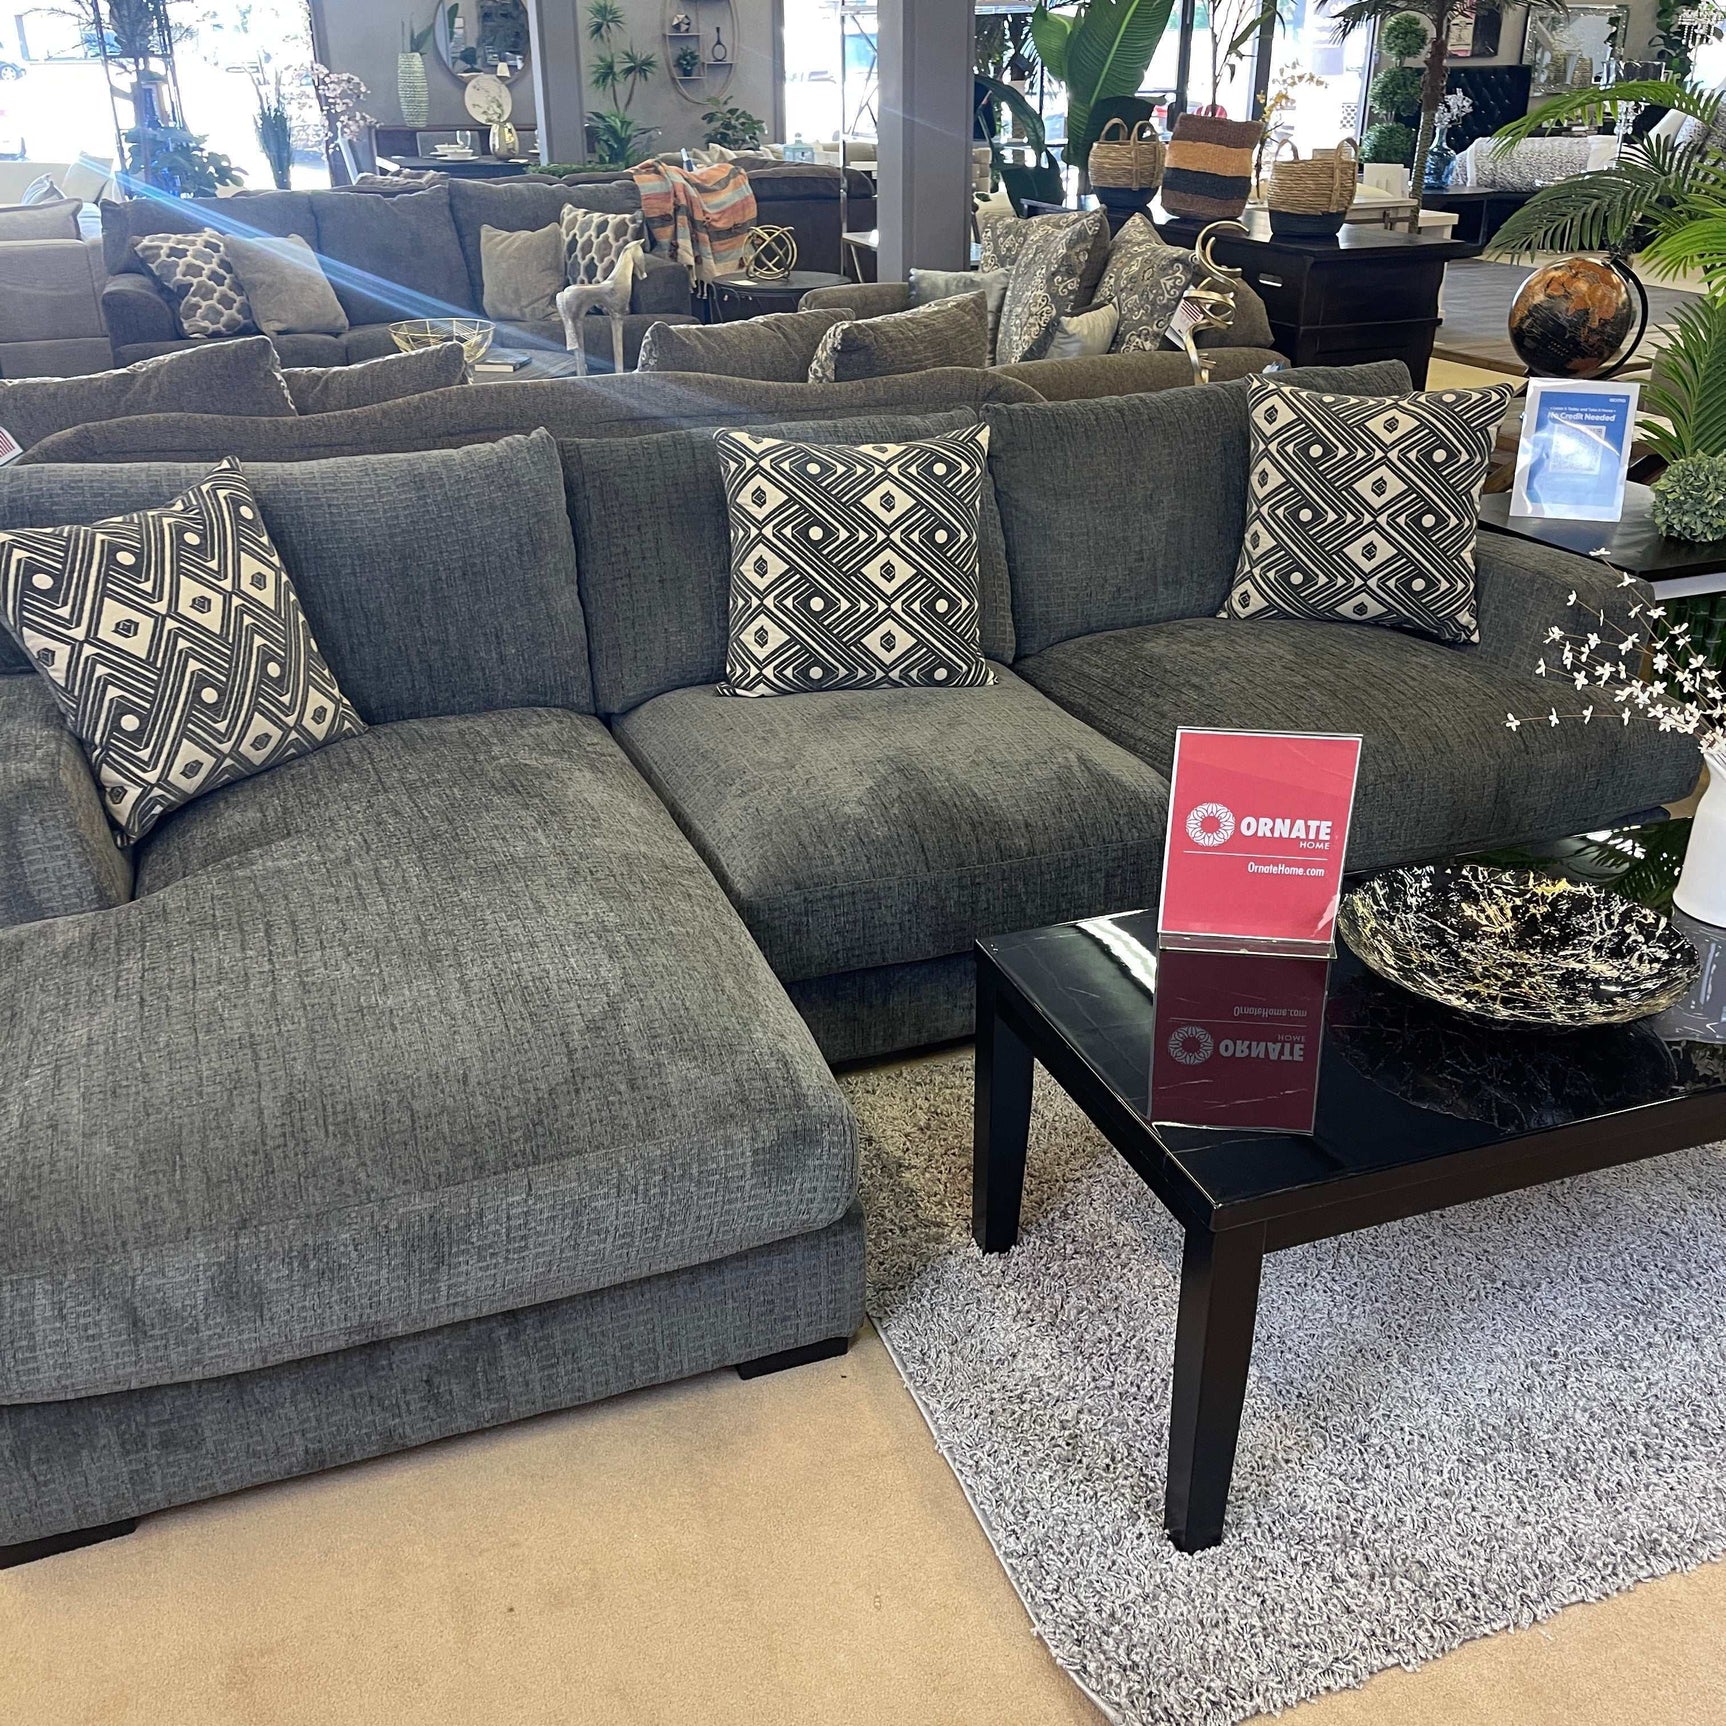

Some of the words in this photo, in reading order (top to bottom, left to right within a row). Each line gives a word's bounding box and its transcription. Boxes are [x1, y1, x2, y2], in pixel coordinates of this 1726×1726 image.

[1560, 412, 1584, 420] Credit
[1584, 413, 1616, 422] Needed
[1240, 817, 1333, 841] ORNATE
[1299, 841, 1331, 850] HOME
[1247, 861, 1325, 877] OrnateHome.com
